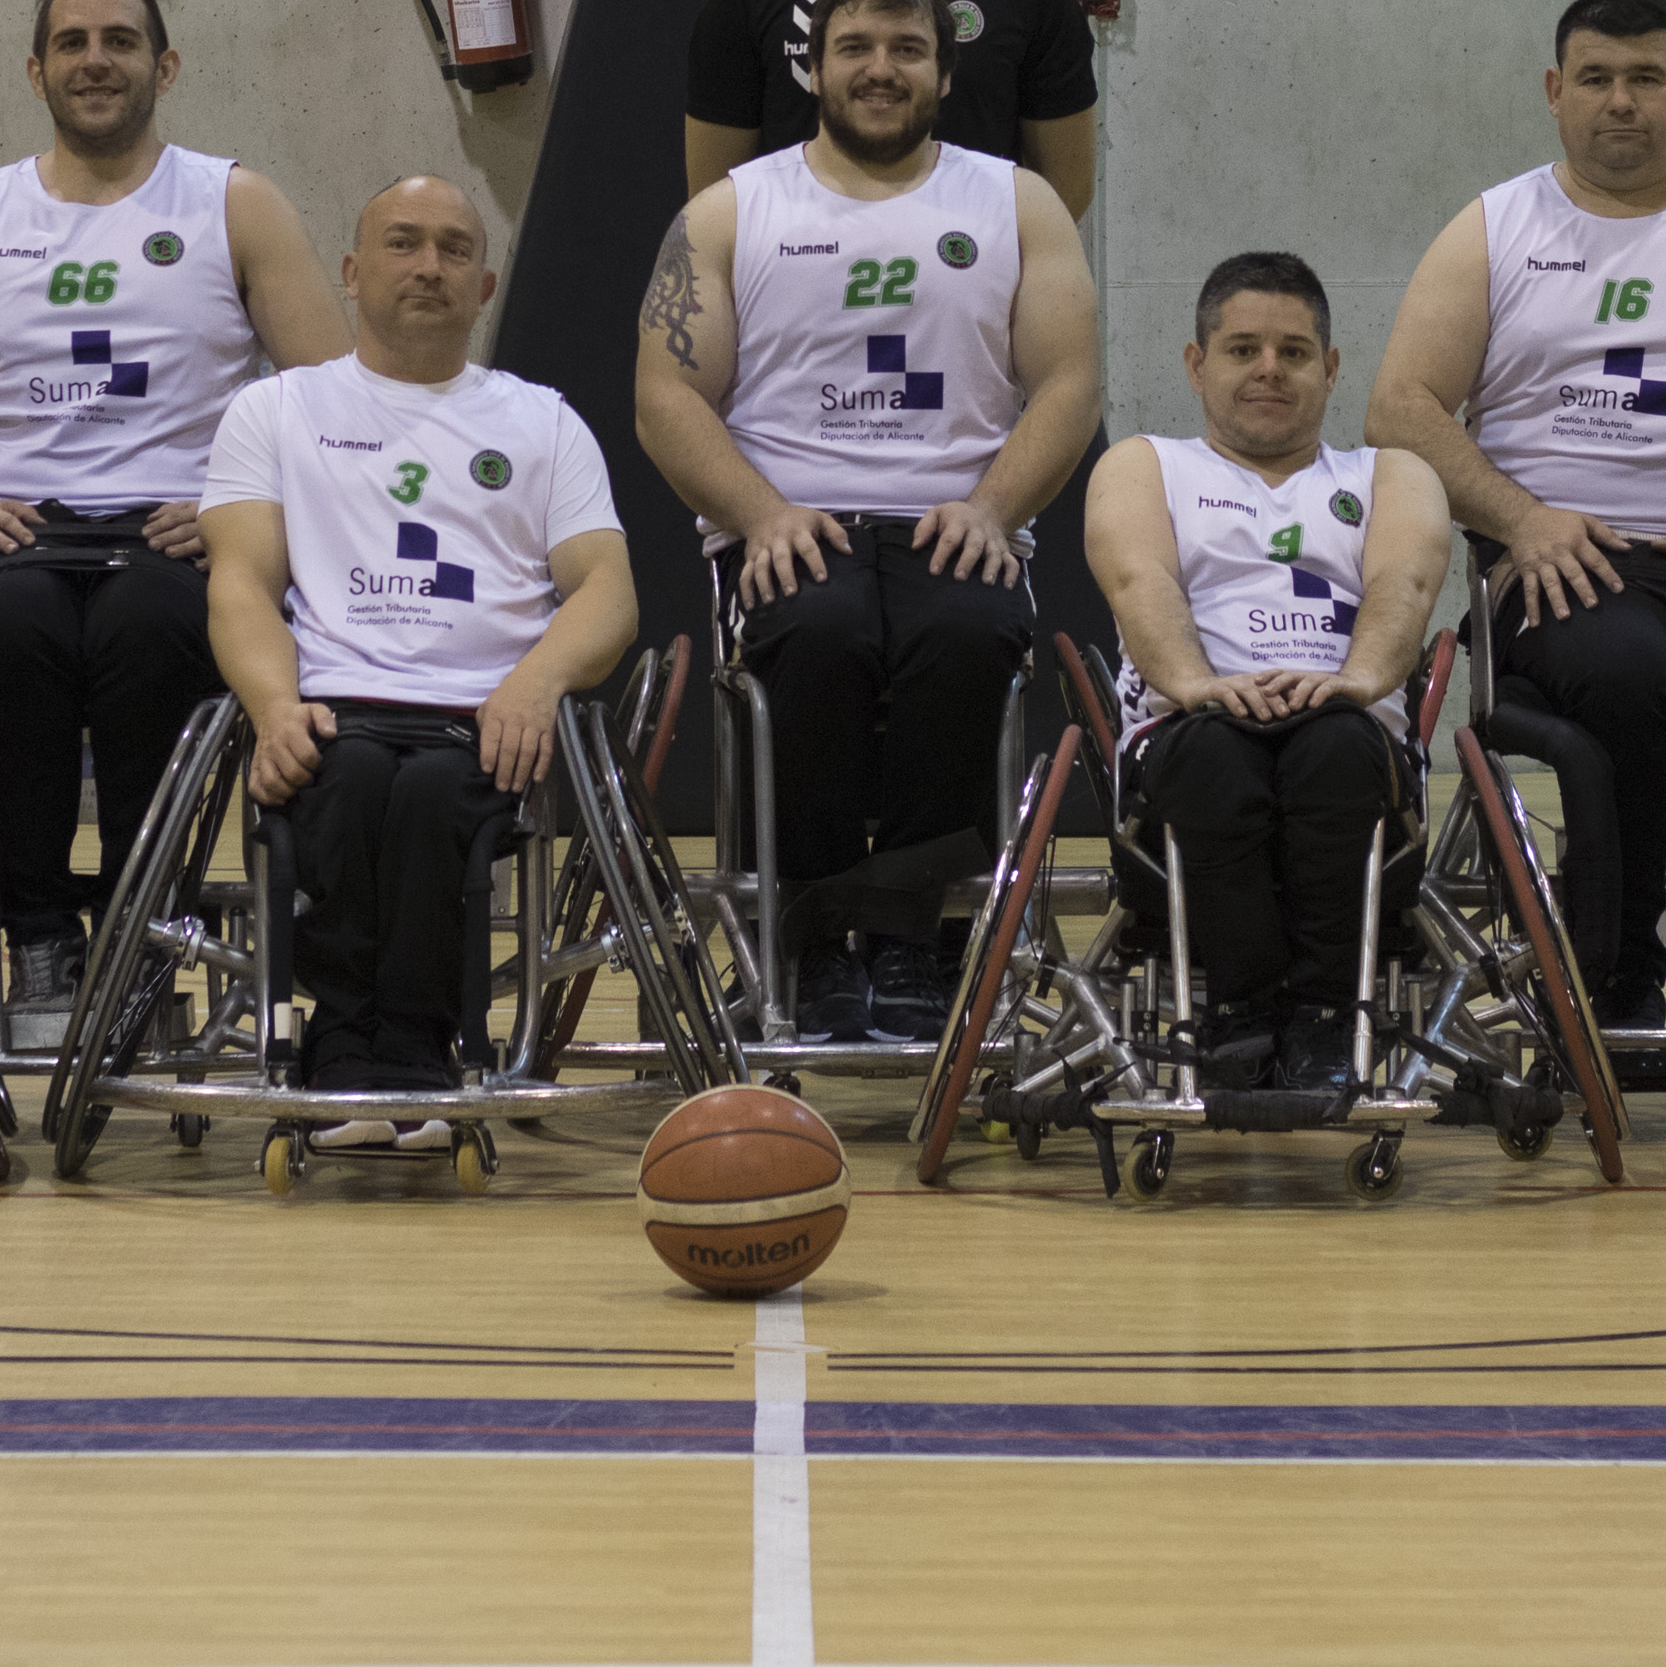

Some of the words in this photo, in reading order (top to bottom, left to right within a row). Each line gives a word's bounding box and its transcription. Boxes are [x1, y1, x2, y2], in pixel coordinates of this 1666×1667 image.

[779, 241, 839, 257] hummel
[1527, 256, 1586, 273] hummel
[46, 259, 121, 307] 66
[842, 256, 919, 310] 22
[1594, 277, 1655, 325] 16
[29, 377, 112, 404] Suma
[820, 383, 906, 411] Suma
[1559, 385, 1640, 412] Suma
[74, 414, 86, 422] de
[88, 415, 126, 425] Alicante
[820, 419, 856, 429] Gestión
[858, 419, 903, 429] Tributaria
[1554, 414, 1586, 425] Gestión
[1588, 417, 1632, 430] Tributaria
[319, 434, 383, 453] hummel
[820, 431, 870, 442] Diputación
[873, 432, 885, 440] de
[887, 431, 925, 441] Alicante
[1551, 425, 1599, 439] Diputación
[1601, 430, 1613, 440] de
[1615, 431, 1653, 444] Alicante
[386, 459, 432, 507] 3
[1198, 496, 1257, 518] hummel
[1266, 521, 1305, 564] 9
[349, 567, 436, 597] Suma
[347, 603, 382, 614] Gestión
[385, 603, 431, 615] Tributaria
[346, 615, 396, 626] Diputación
[399, 616, 411, 625] de
[414, 616, 454, 630] Alicante
[1248, 609, 1336, 634] Suma
[1251, 640, 1289, 650] Gestión
[1293, 640, 1337, 652] Tributaria
[1251, 651, 1306, 662] Diputación
[1309, 652, 1321, 660] de
[687, 1233, 810, 1268] molten
